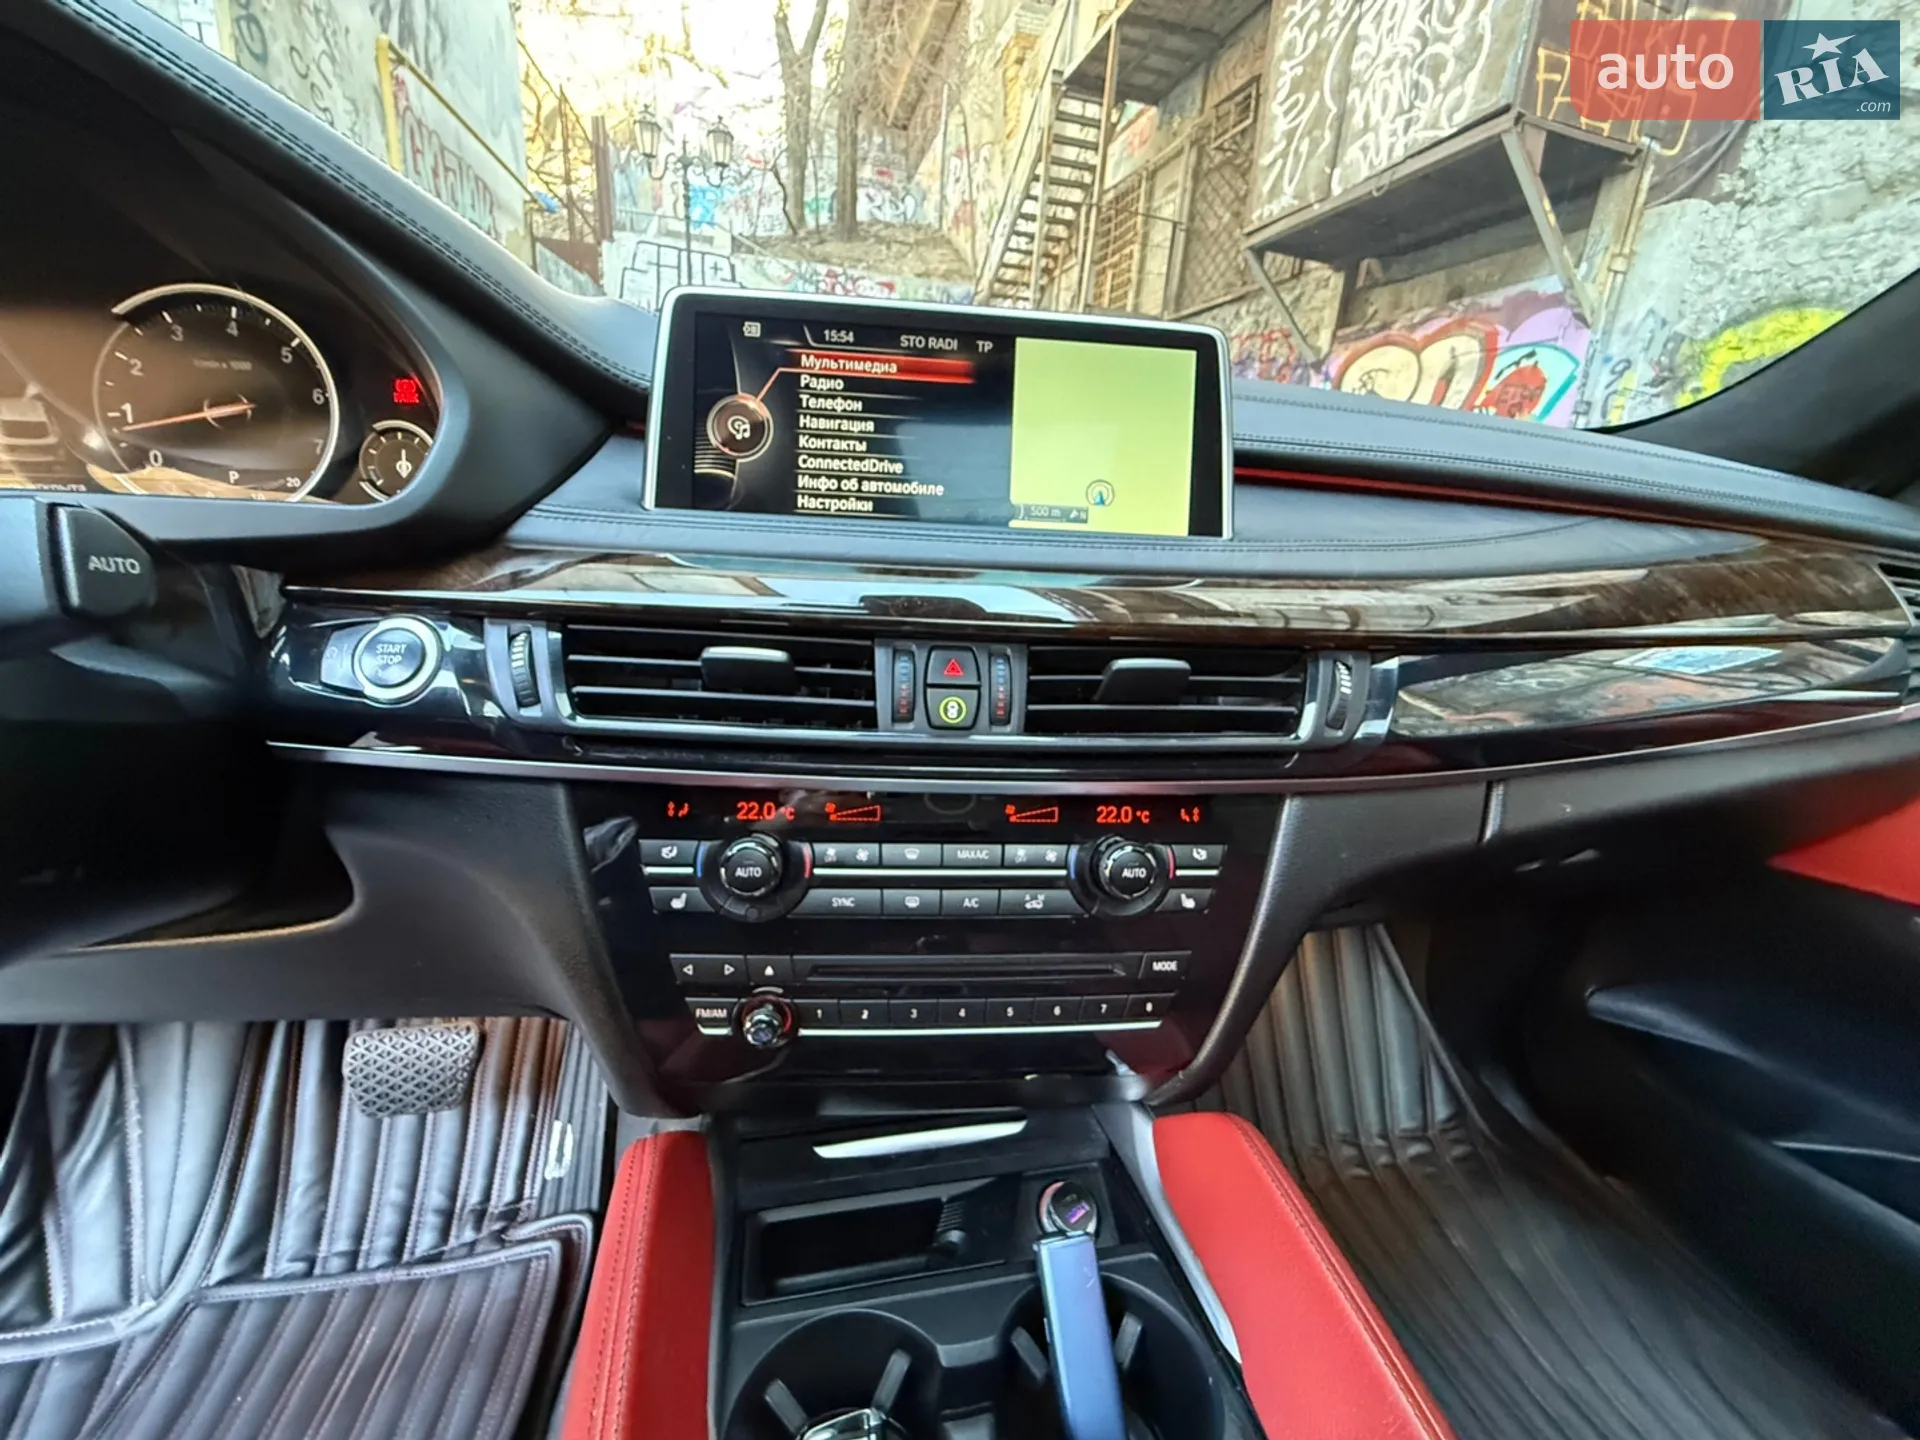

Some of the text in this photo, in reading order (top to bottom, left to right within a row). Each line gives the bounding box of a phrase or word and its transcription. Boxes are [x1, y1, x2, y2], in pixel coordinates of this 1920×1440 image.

[170, 325, 184, 341] 3
[225, 321, 239, 337] 4
[823, 329, 855, 343] 15:54
[900, 335, 958, 351] STO RADI
[976, 340, 994, 353] TP
[281, 346, 293, 363] 5
[129, 358, 144, 376] 2
[800, 354, 898, 374] Мультимедиа
[800, 374, 845, 390] Радио
[312, 388, 324, 404] 6
[799, 394, 863, 412] Телефон
[120, 403, 134, 424] 1
[799, 414, 875, 433] Навигация
[313, 438, 324, 455] 7
[798, 435, 867, 452] Контакты
[149, 450, 163, 467] 0
[798, 454, 904, 474] ConnectedDrive
[228, 470, 240, 484] P
[286, 477, 301, 488] 20
[797, 475, 945, 496] Инфо об автомобиле
[797, 495, 874, 512] Настройки
[1030, 505, 1050, 517] 500
[88, 556, 140, 575] AUTO
[376, 644, 406, 654] START
[377, 655, 402, 665] STOP
[736, 801, 776, 821] 22.0
[1096, 805, 1133, 824] 22.0
[735, 866, 762, 879] AUTO
[1122, 867, 1147, 879] AUTO
[832, 897, 855, 907] SYNC
[963, 898, 979, 908] A/C
[1152, 961, 1177, 972] MODE
[816, 1009, 822, 1019] 1
[861, 1009, 869, 1019] 2
[910, 1009, 918, 1019] 3
[958, 1008, 966, 1018] 4
[1006, 1007, 1014, 1017] 5
[1053, 1005, 1061, 1016] 6
[1100, 1004, 1108, 1014] 7
